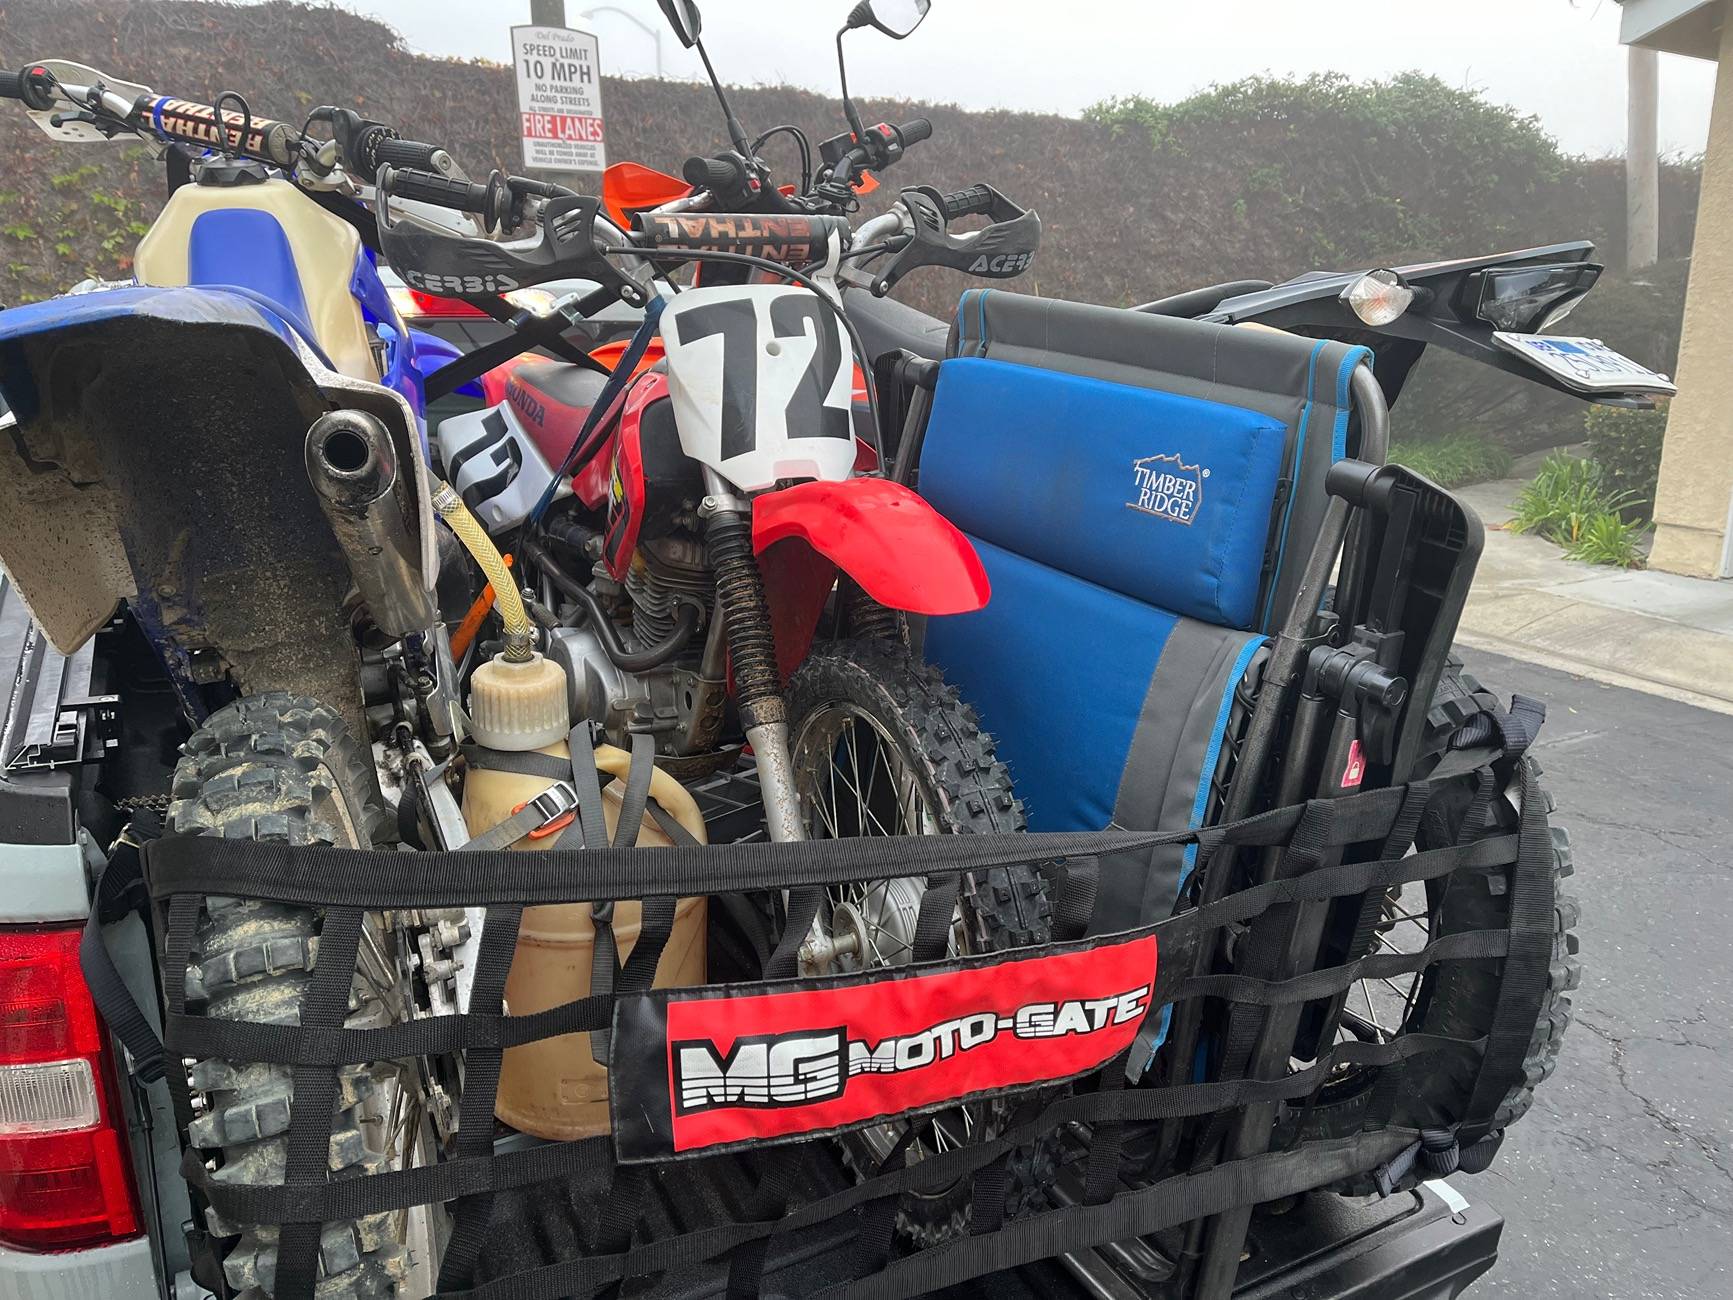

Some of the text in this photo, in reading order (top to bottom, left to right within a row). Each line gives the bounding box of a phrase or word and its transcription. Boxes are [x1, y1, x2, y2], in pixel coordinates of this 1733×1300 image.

[522, 43, 589, 61] SPEED LIMIT
[523, 59, 592, 84] 10 MPH
[530, 93, 590, 107] ALONG STREETS
[534, 83, 584, 96] NO PARKING
[522, 113, 603, 141] FIRE LANES
[399, 268, 519, 293] CERBIS
[675, 298, 851, 462] 72
[1133, 466, 1196, 501] TIMBER
[1138, 487, 1192, 520] RIDGE
[680, 985, 1150, 1109] MG MOTO-GATE
